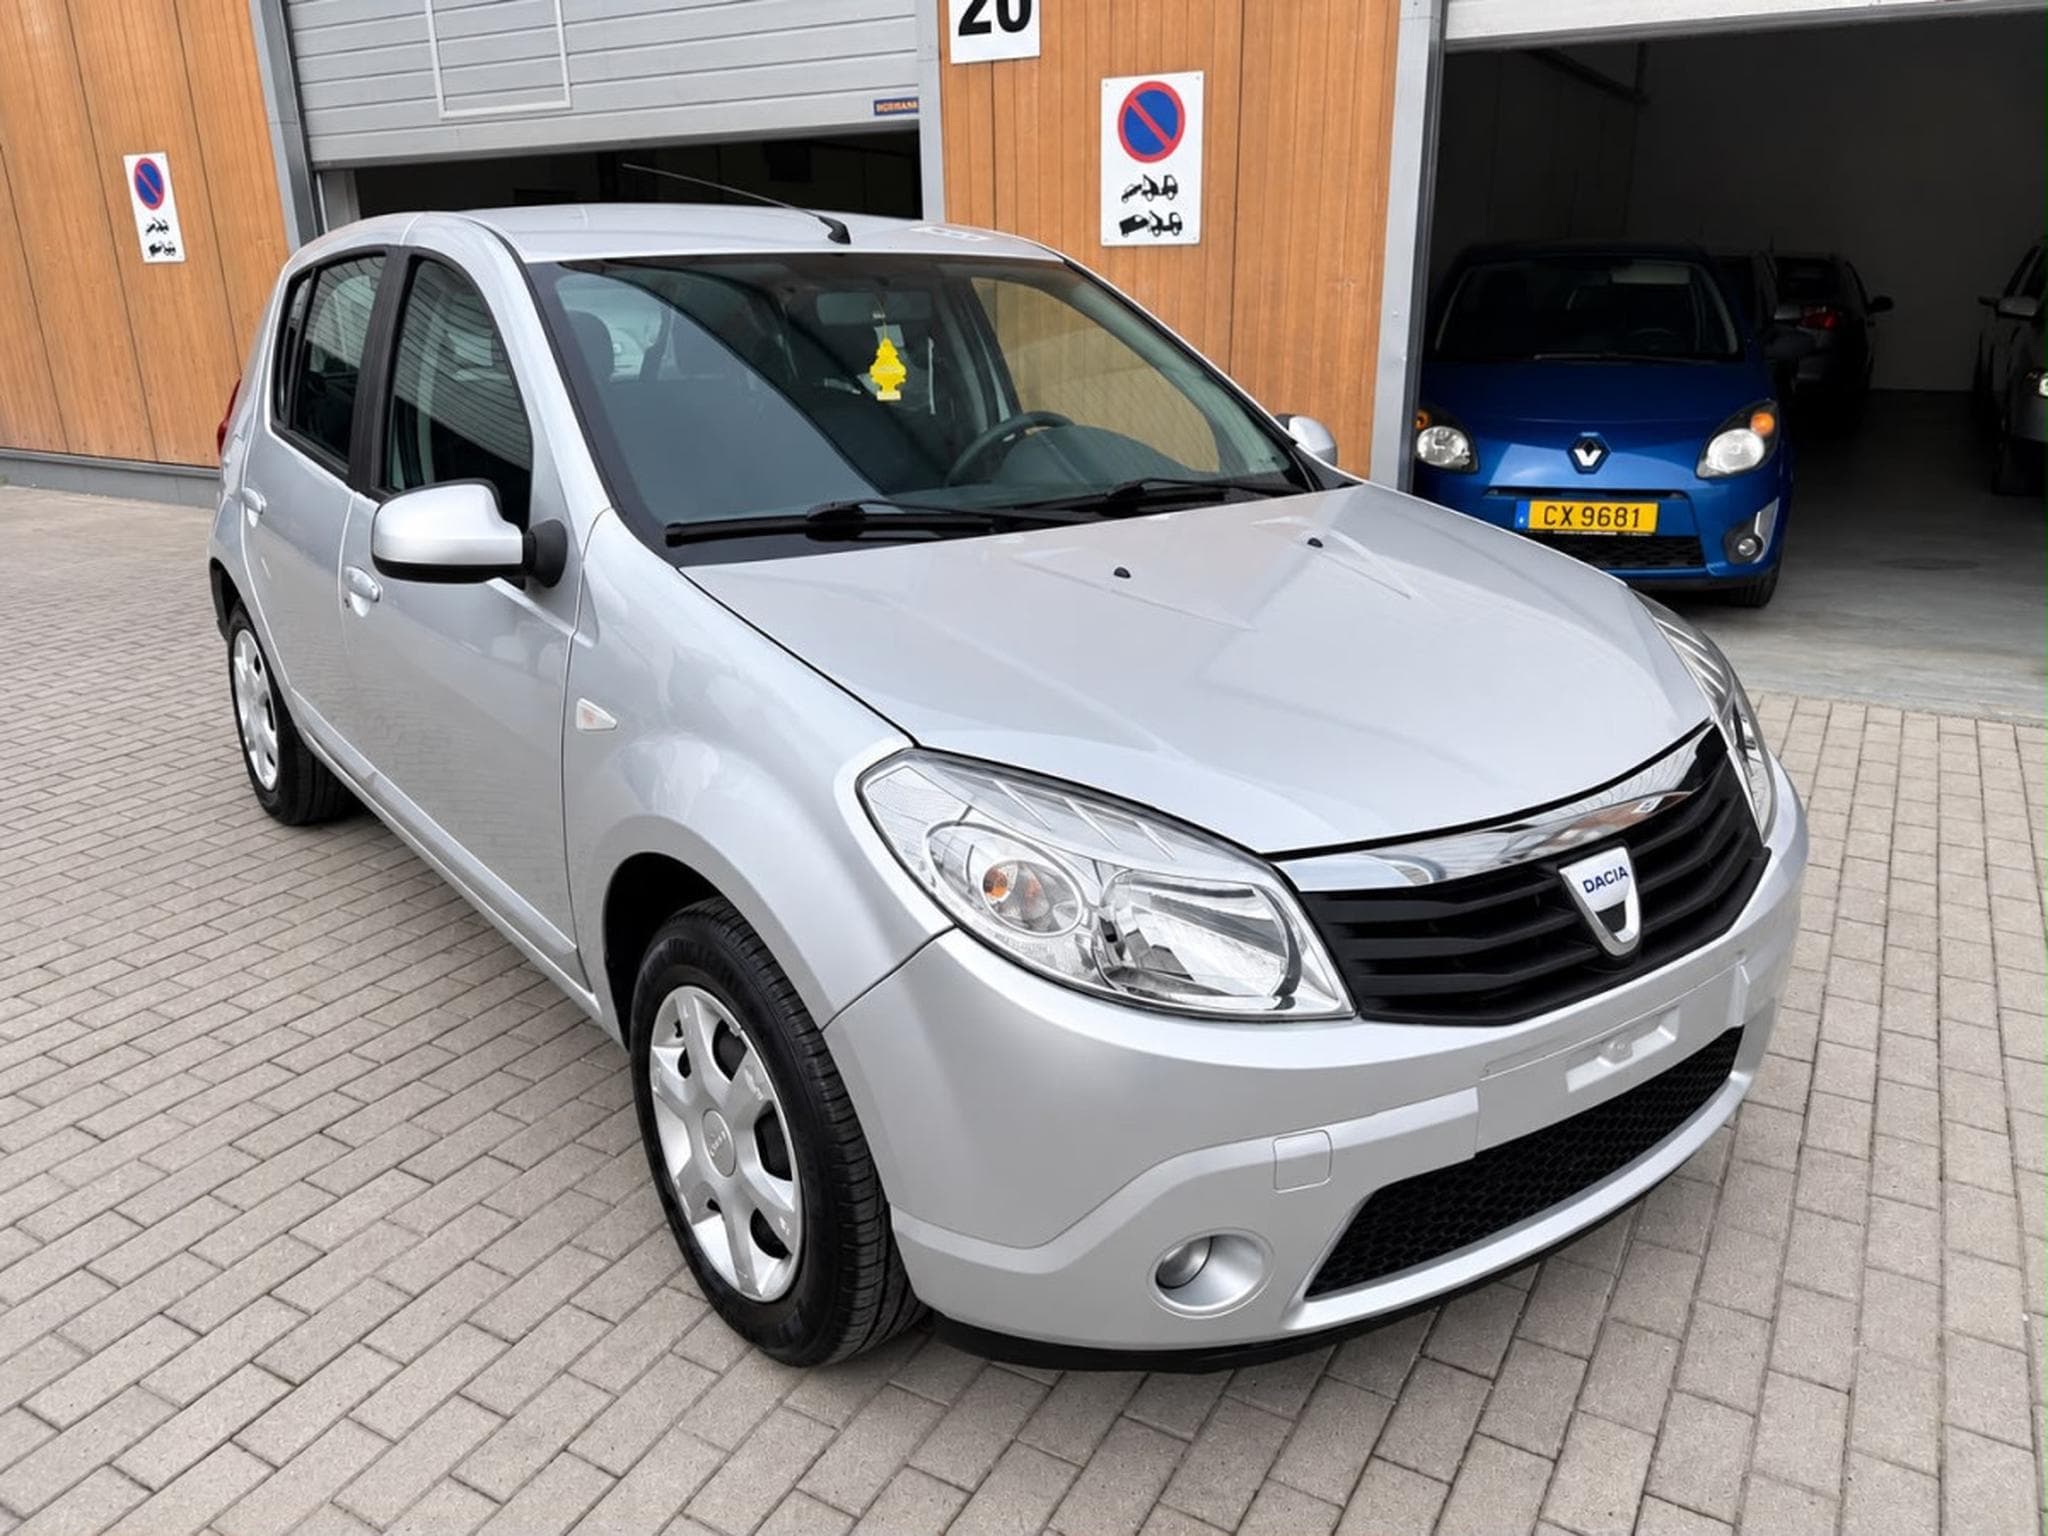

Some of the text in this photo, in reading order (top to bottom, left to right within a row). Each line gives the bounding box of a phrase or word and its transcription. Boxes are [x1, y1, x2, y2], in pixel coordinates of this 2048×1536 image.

[1544, 505, 1640, 528] CX 9681
[1582, 866, 1629, 893] DACIA
